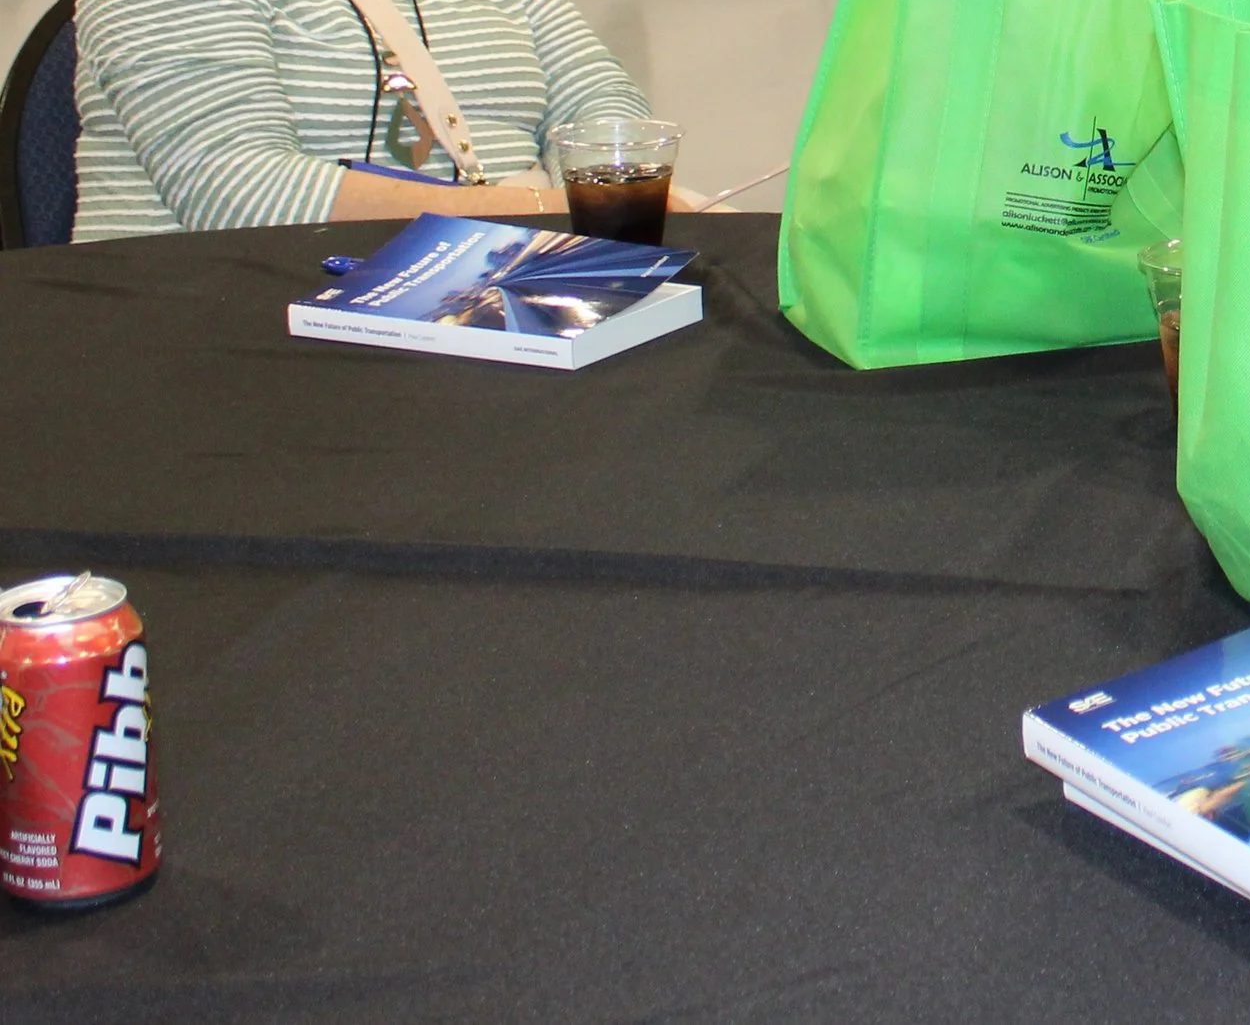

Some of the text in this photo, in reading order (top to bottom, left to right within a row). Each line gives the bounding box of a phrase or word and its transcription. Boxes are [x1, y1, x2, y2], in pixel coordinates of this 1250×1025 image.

[1021, 163, 1072, 180] ALISON
[1075, 171, 1084, 182] &
[350, 241, 452, 304] The New Future of
[368, 231, 486, 307] Public Transportation
[365, 327, 402, 338] Transportation
[1102, 711, 1152, 733] The
[1152, 691, 1206, 716] New
[1120, 712, 1199, 745] Public
[72, 640, 148, 863] Pibb
[1097, 778, 1137, 809] Transportation
[19, 844, 57, 856] FLAVORED
[36, 857, 59, 868] SODA
